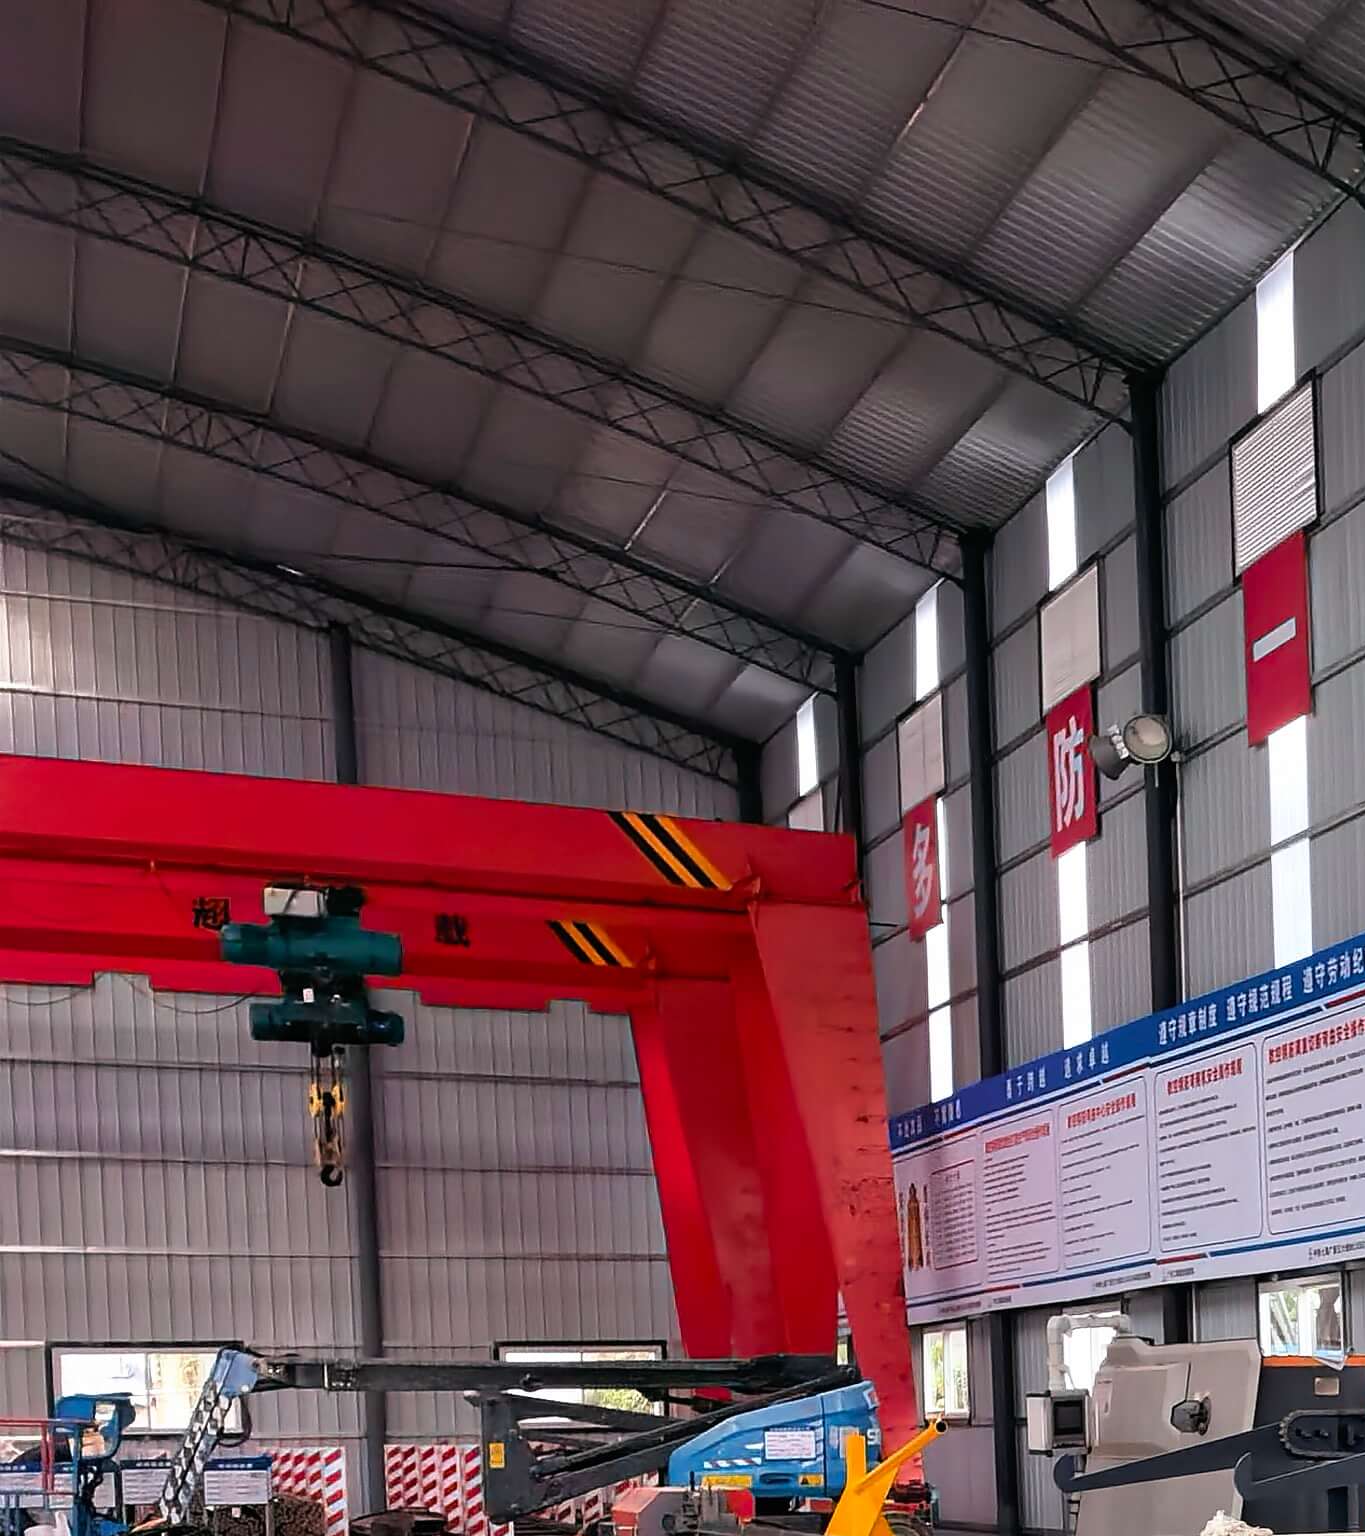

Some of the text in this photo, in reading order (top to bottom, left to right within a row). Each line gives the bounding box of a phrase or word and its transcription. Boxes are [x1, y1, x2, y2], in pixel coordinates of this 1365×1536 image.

[1253, 617, 1296, 662] 一
[1053, 715, 1085, 832] 防
[912, 823, 934, 919] 多
